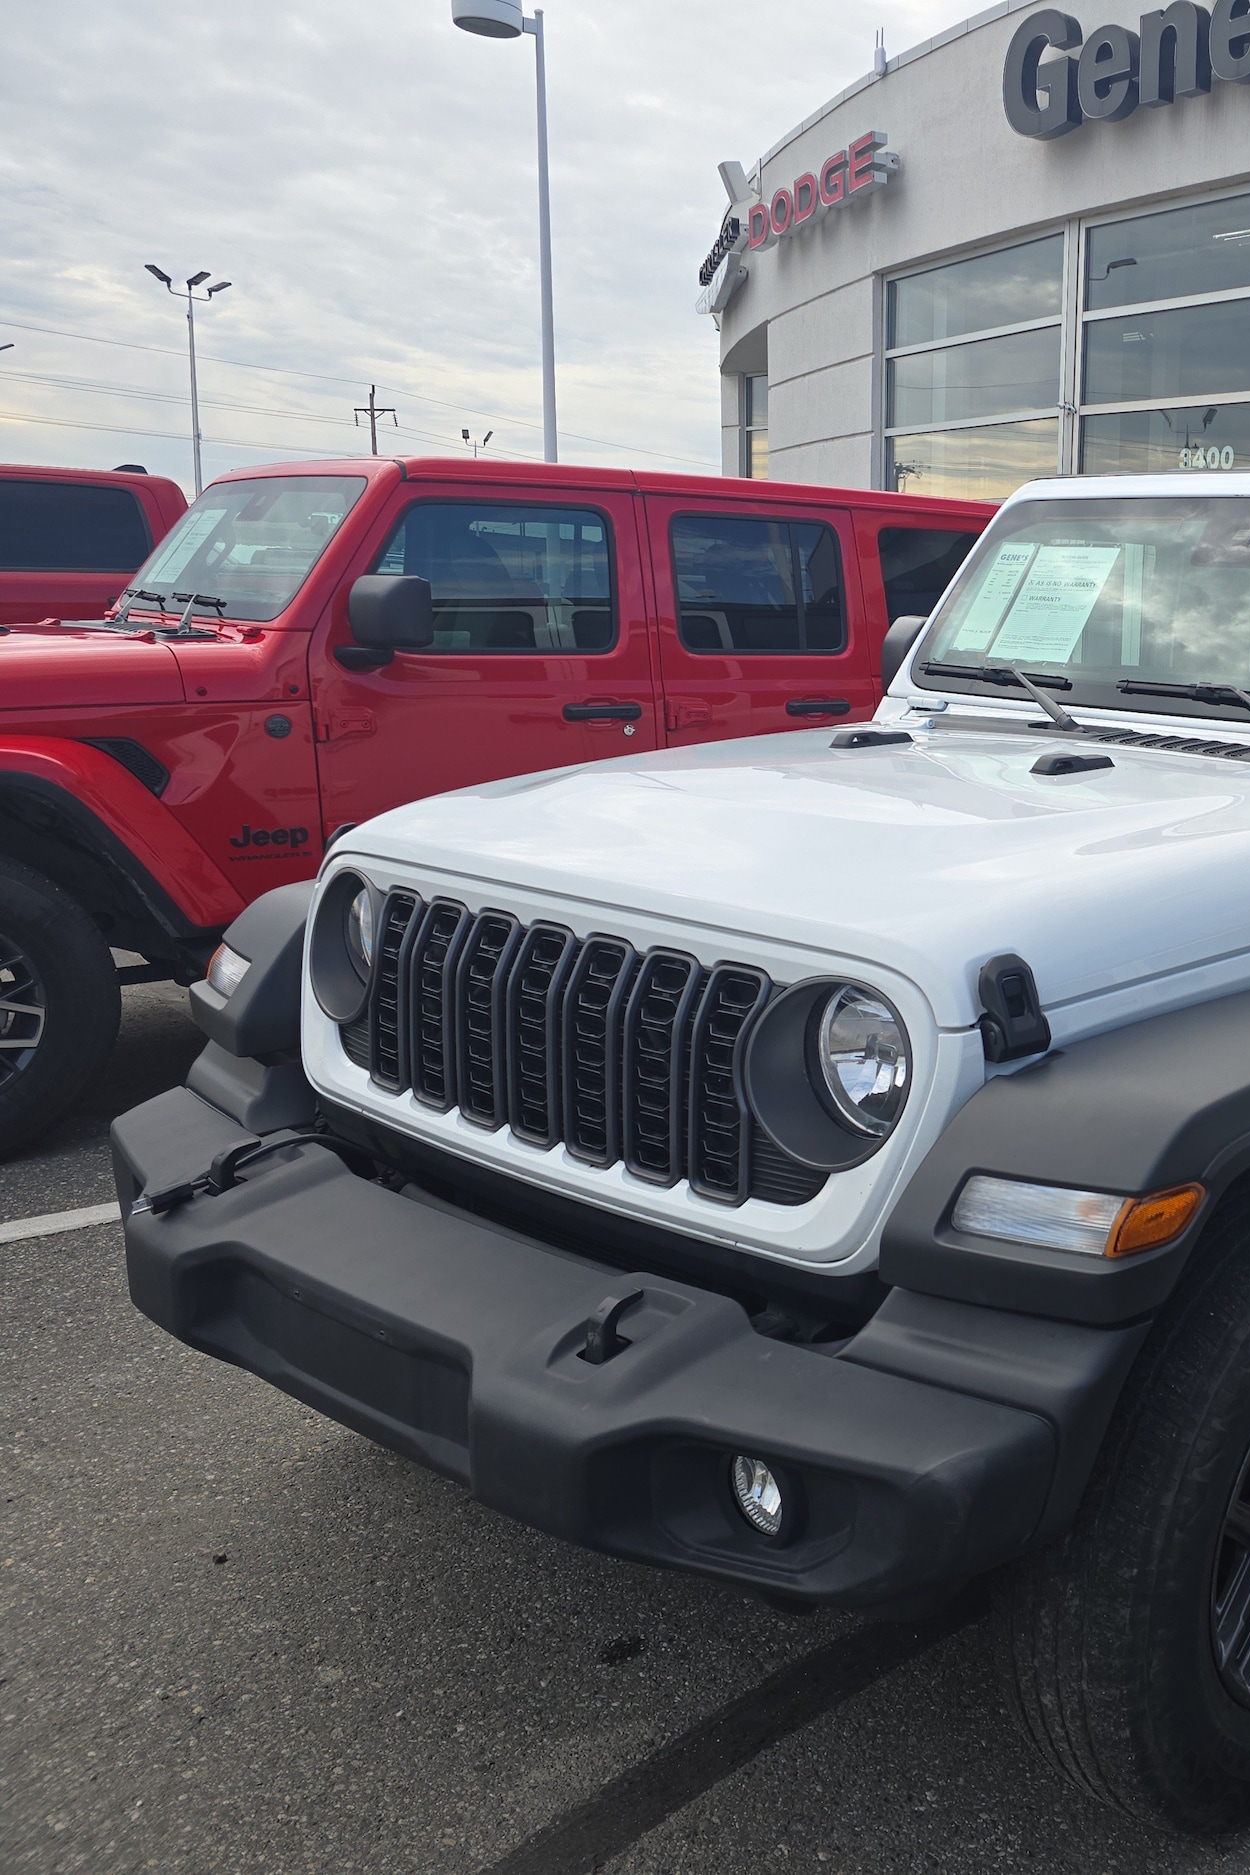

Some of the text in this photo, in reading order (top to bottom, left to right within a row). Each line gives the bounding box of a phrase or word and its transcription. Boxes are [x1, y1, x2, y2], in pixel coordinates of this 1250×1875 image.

[748, 130, 887, 253] DODGE
[1000, 553, 1029, 562] GENE'S
[229, 824, 309, 848] Jeep
